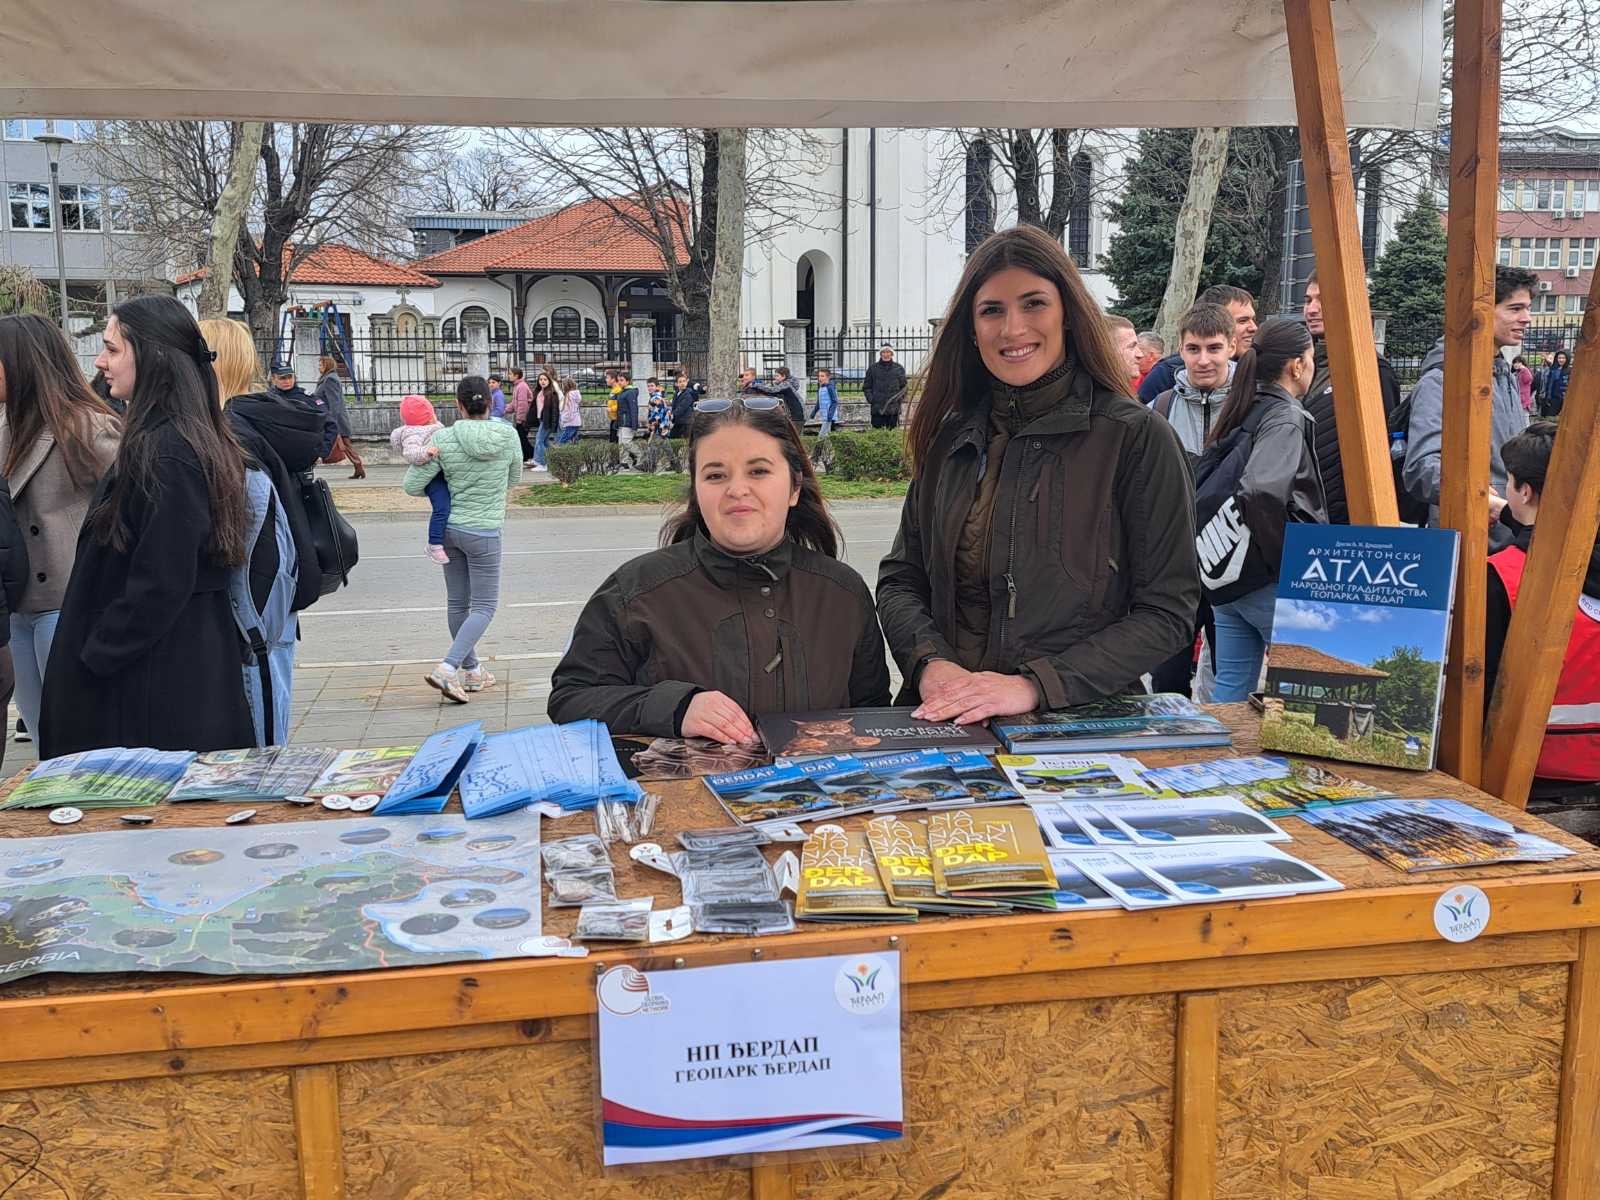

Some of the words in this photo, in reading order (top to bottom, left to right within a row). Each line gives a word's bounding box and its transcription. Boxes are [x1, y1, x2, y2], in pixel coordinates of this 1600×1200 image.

[1196, 496, 1241, 574] NIKE
[1308, 548, 1421, 561] АРХИТЕКТОНСКИ
[1301, 557, 1420, 588] АТЛАС
[1291, 580, 1345, 592] НАРОДНОГ
[1347, 583, 1428, 598] ГРАДИТЕЉСТВА
[1310, 590, 1360, 602] ГЕОПАРКА
[1364, 594, 1404, 605] ЂЕРДАП
[943, 851, 1008, 866] DAP
[891, 866, 933, 877] DA
[810, 875, 875, 888] DAP
[687, 1045, 721, 1063] НП
[727, 1036, 820, 1060] ЂЕРДАП
[675, 1063, 758, 1084] ГЕОПАРК
[763, 1057, 832, 1077] ЂЕРДАП
